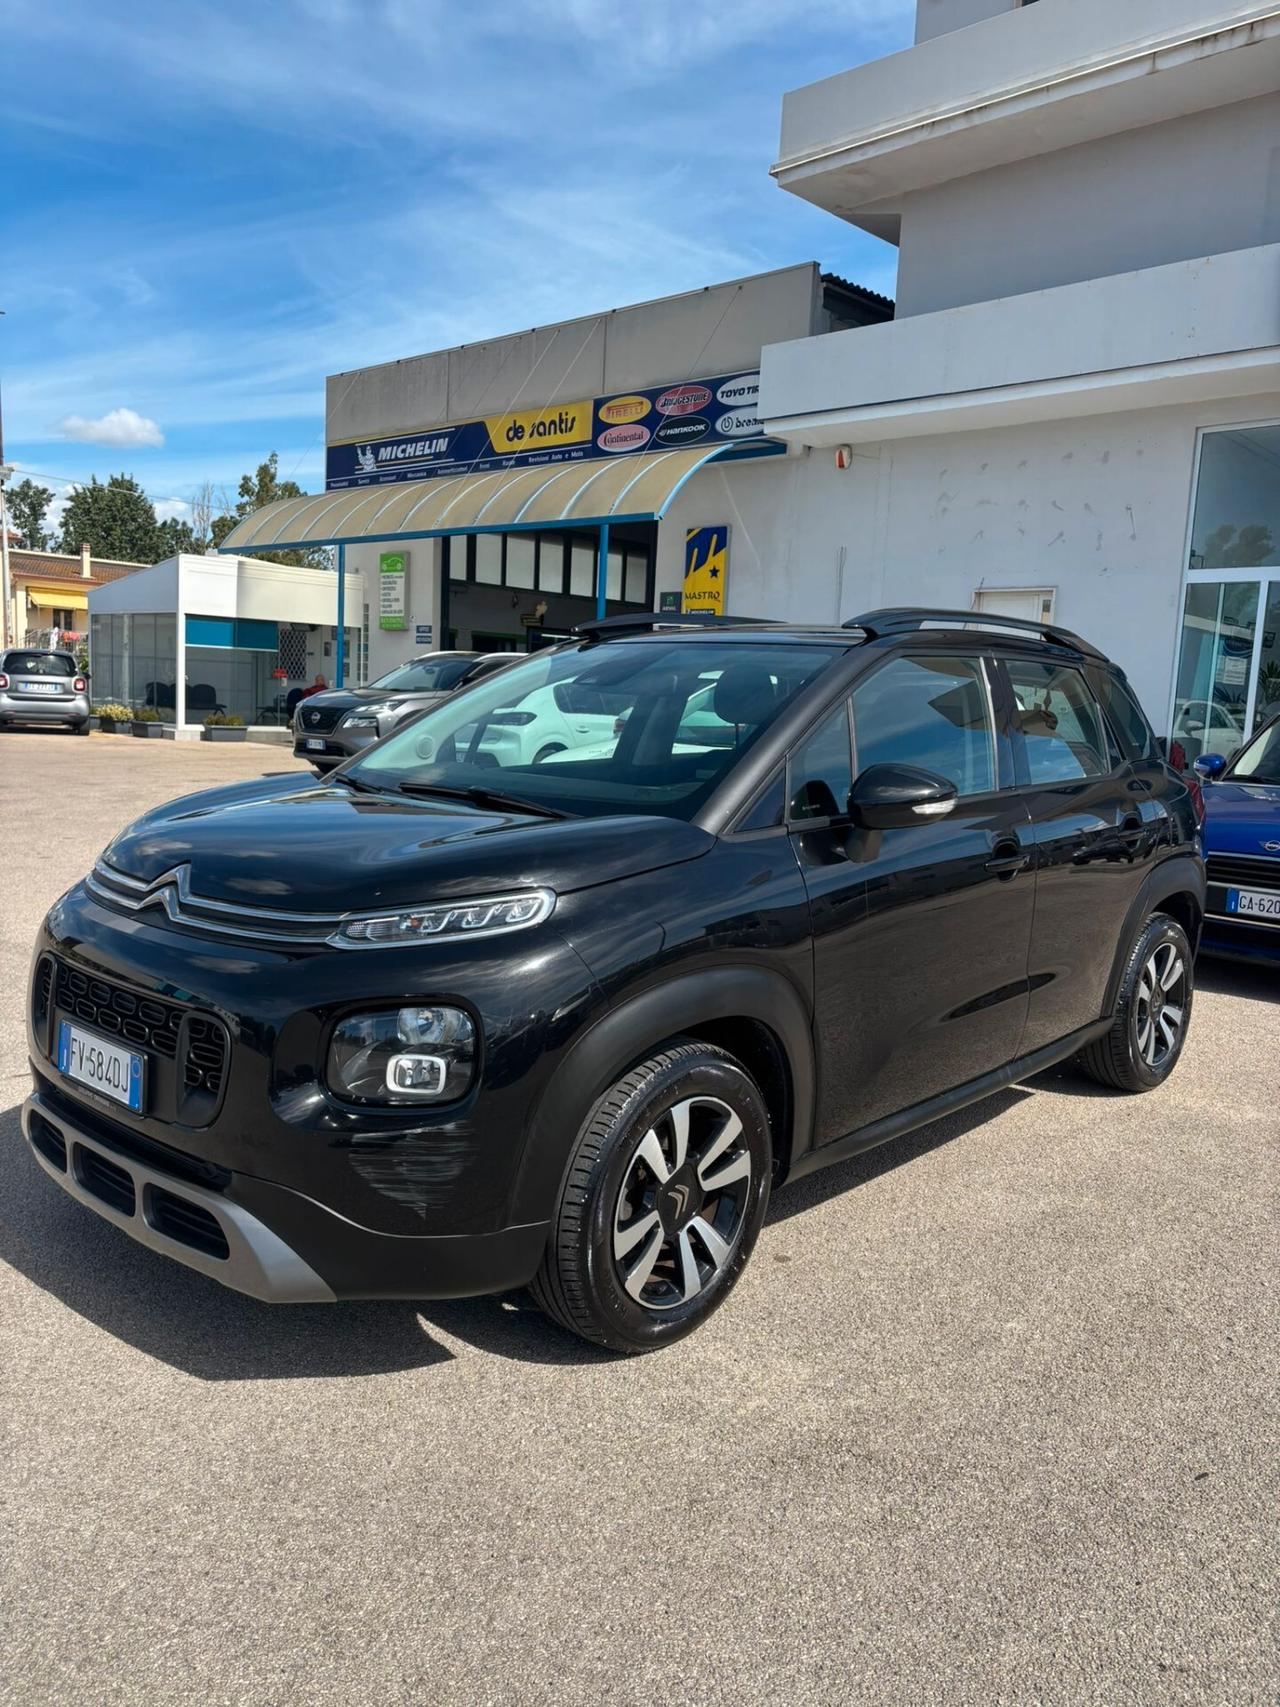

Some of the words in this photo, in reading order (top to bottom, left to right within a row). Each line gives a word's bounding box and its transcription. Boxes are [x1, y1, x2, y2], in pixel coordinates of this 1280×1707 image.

[660, 391, 708, 408] BRIDGESTONE
[720, 386, 745, 399] TOYO
[605, 401, 644, 421] PIRELLI
[505, 419, 525, 442] de
[528, 411, 576, 439] santis
[603, 430, 644, 447] Continental
[377, 437, 449, 461] MICHELIN
[684, 591, 721, 600] MASTRO
